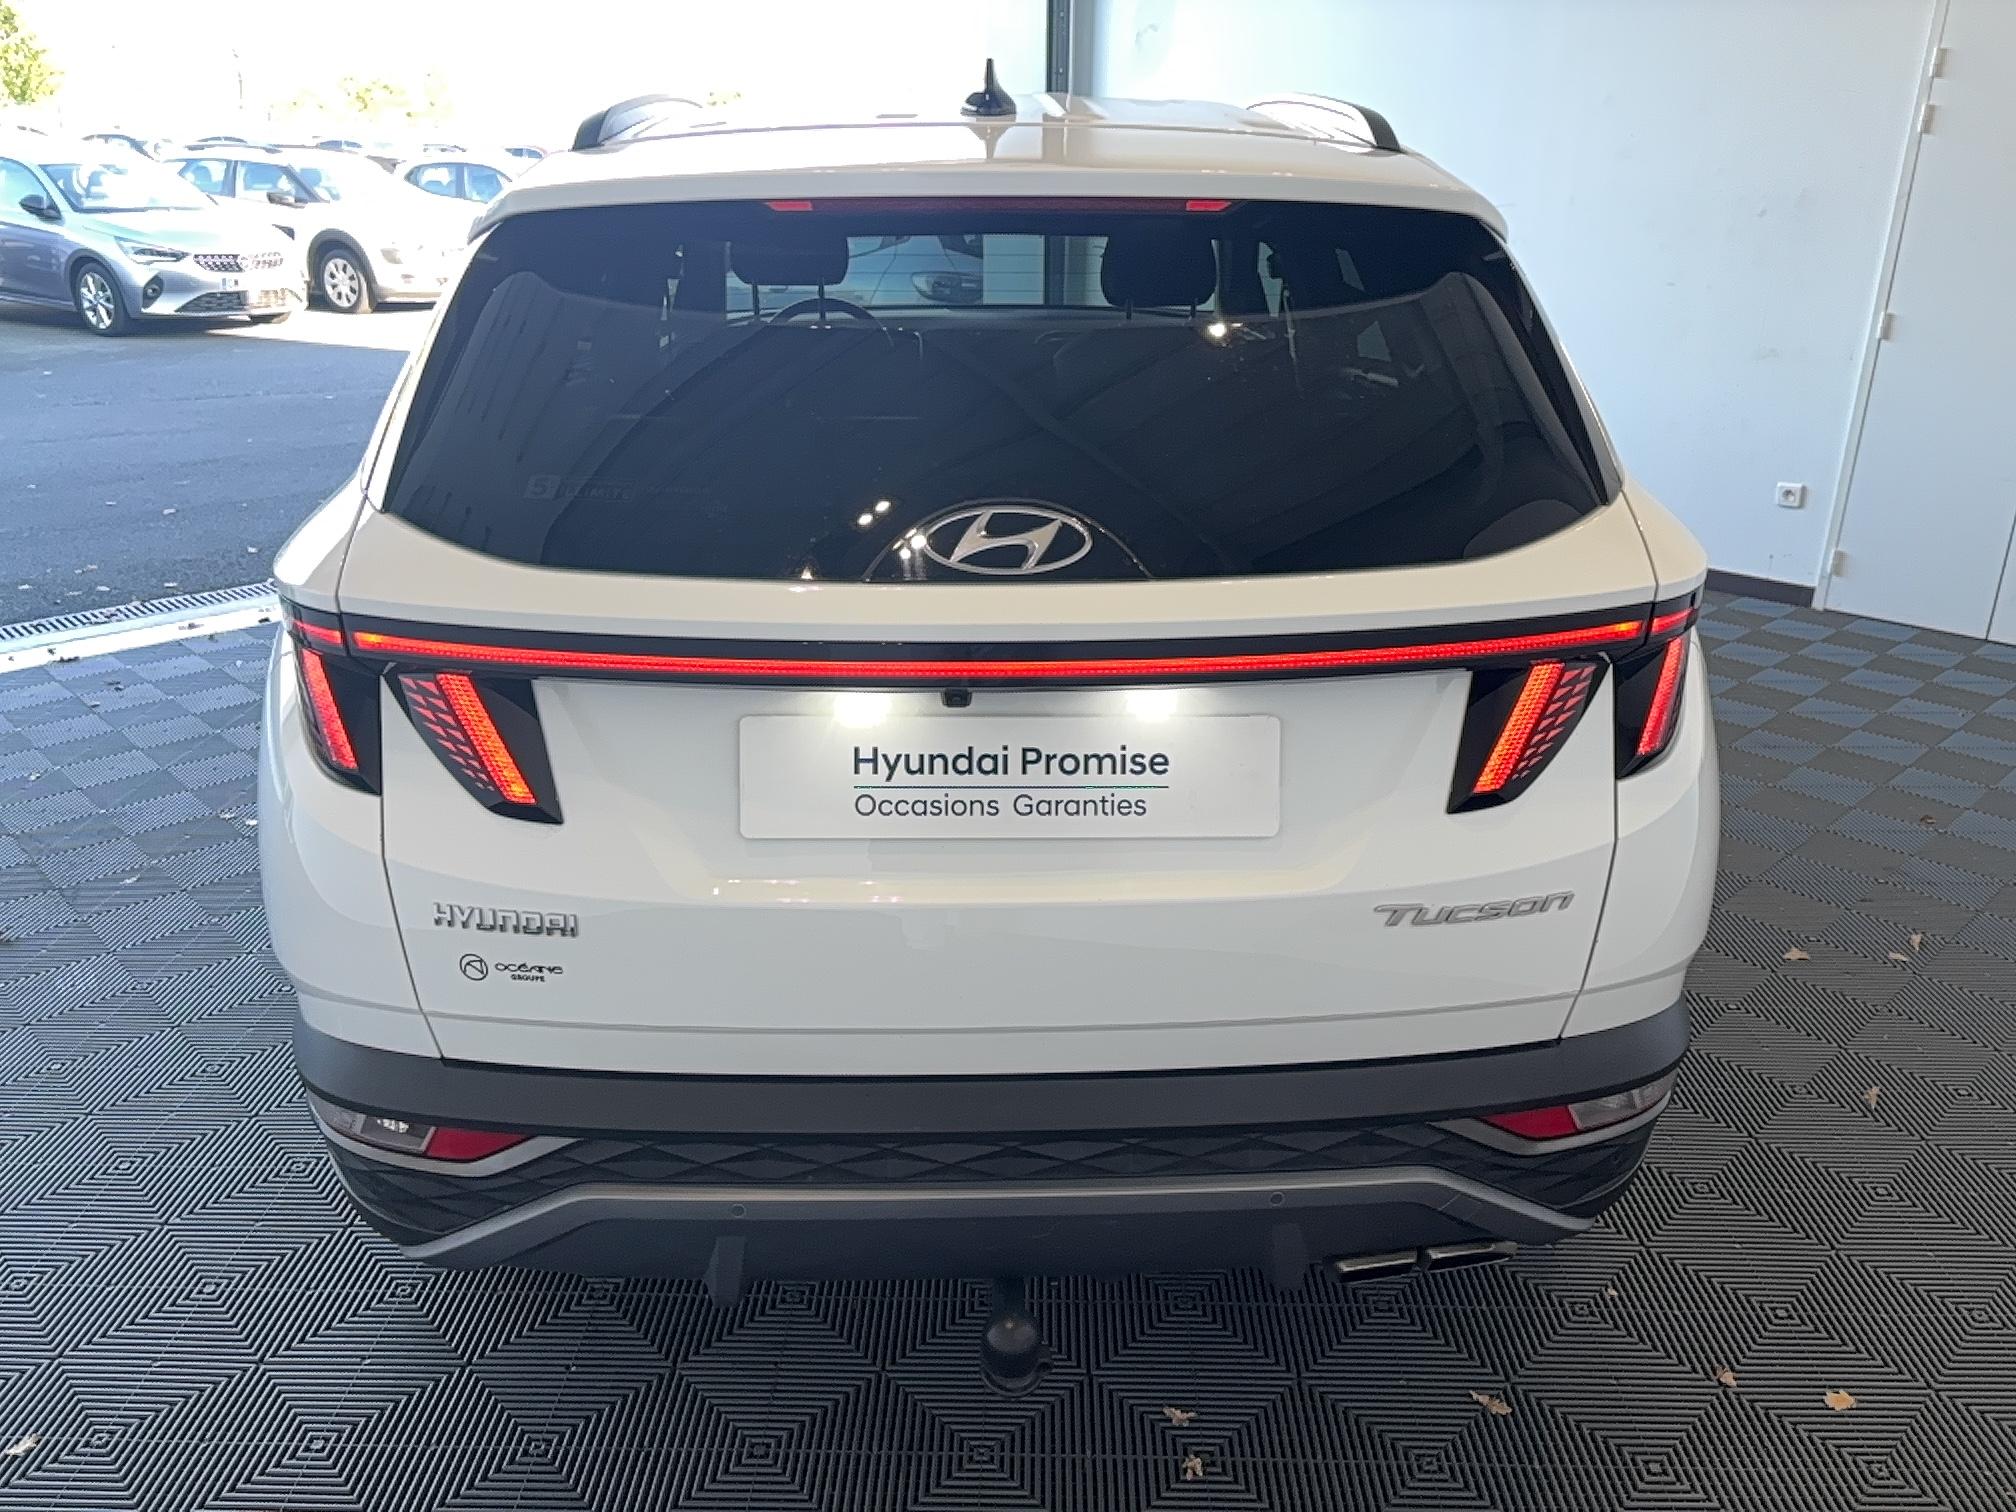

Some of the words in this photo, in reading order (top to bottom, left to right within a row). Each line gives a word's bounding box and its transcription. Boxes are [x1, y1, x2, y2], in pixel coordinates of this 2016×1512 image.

[854, 745, 1009, 782] Hyundai
[1021, 745, 1170, 776] Promise
[855, 793, 1000, 817] Occasions
[1014, 792, 1147, 817] Garanties
[433, 902, 579, 937] HYUNDAI
[1374, 890, 1576, 927] TUCSON
